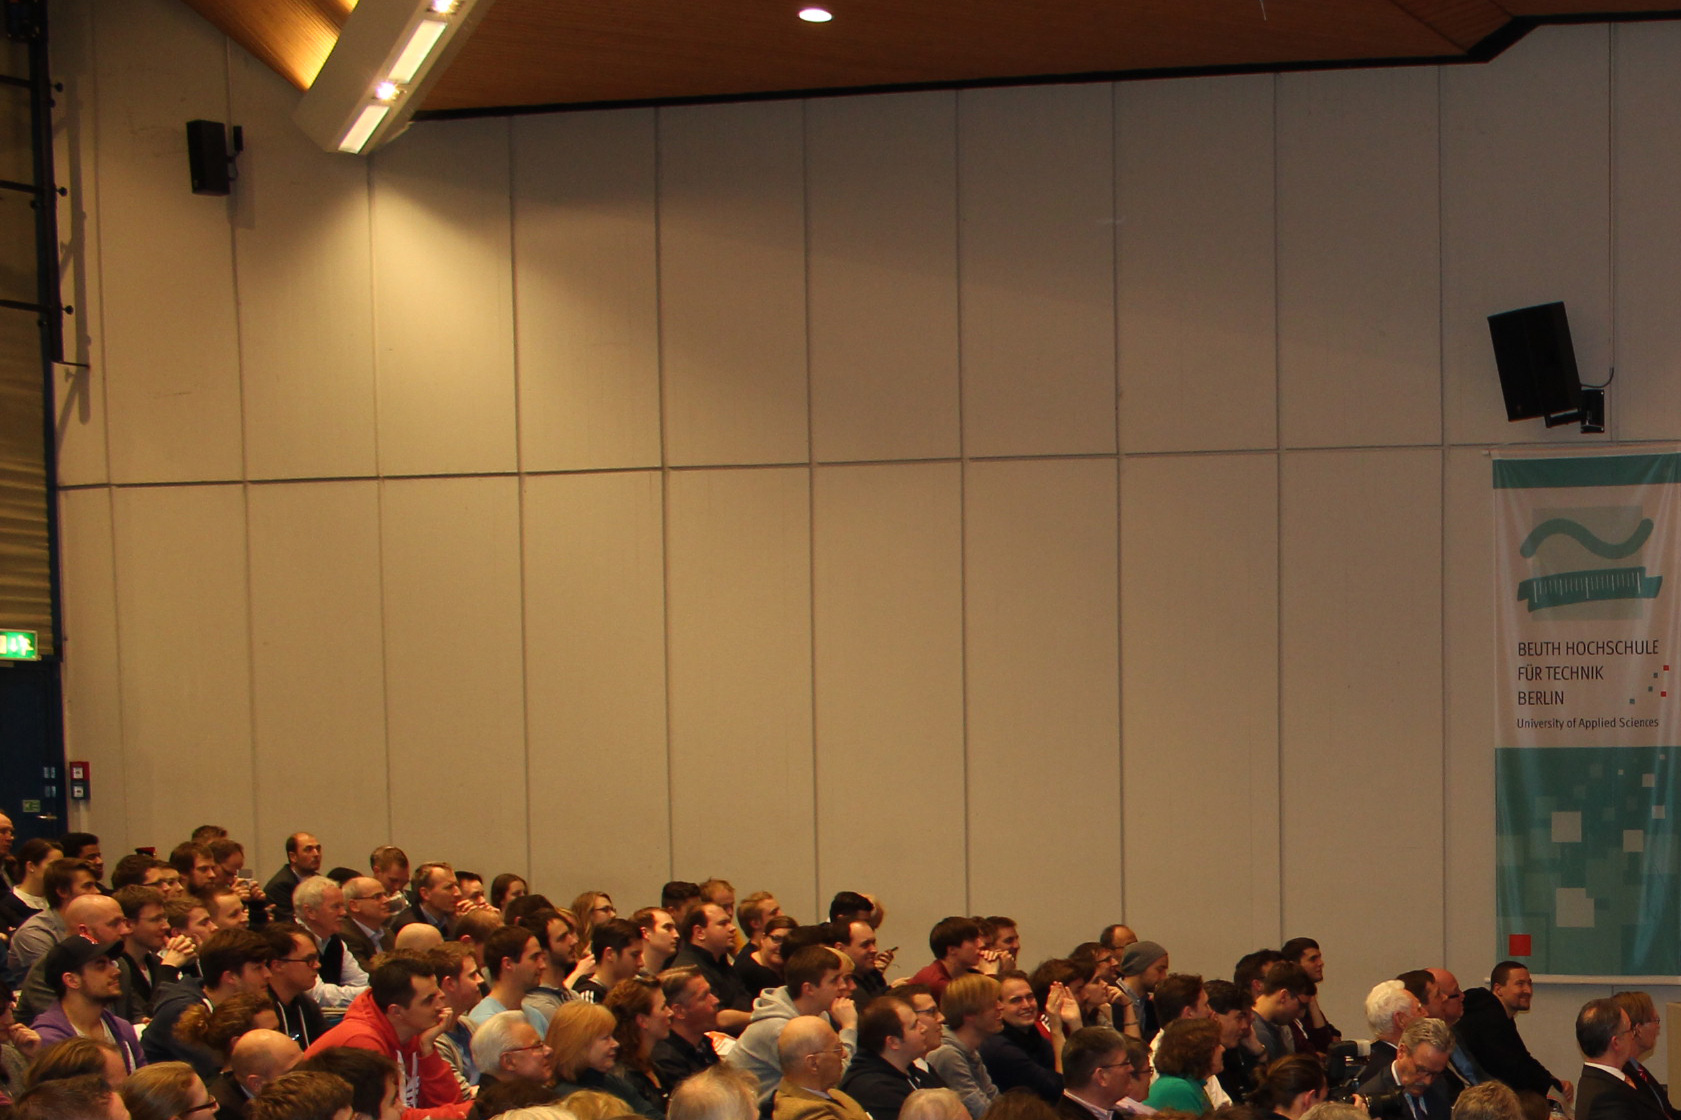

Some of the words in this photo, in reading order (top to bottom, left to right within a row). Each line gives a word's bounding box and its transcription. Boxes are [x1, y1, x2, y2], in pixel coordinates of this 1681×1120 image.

[1518, 641, 1561, 656] BEUTH
[1566, 640, 1659, 656] HOCHSCHULE
[1518, 664, 1542, 681] FÜR
[1546, 665, 1604, 680] TECHNIK
[1518, 691, 1564, 705] BERLIN
[1517, 717, 1565, 730] University
[1567, 717, 1577, 729] of
[1579, 717, 1616, 730] Applied
[1619, 717, 1659, 729] Sciences
